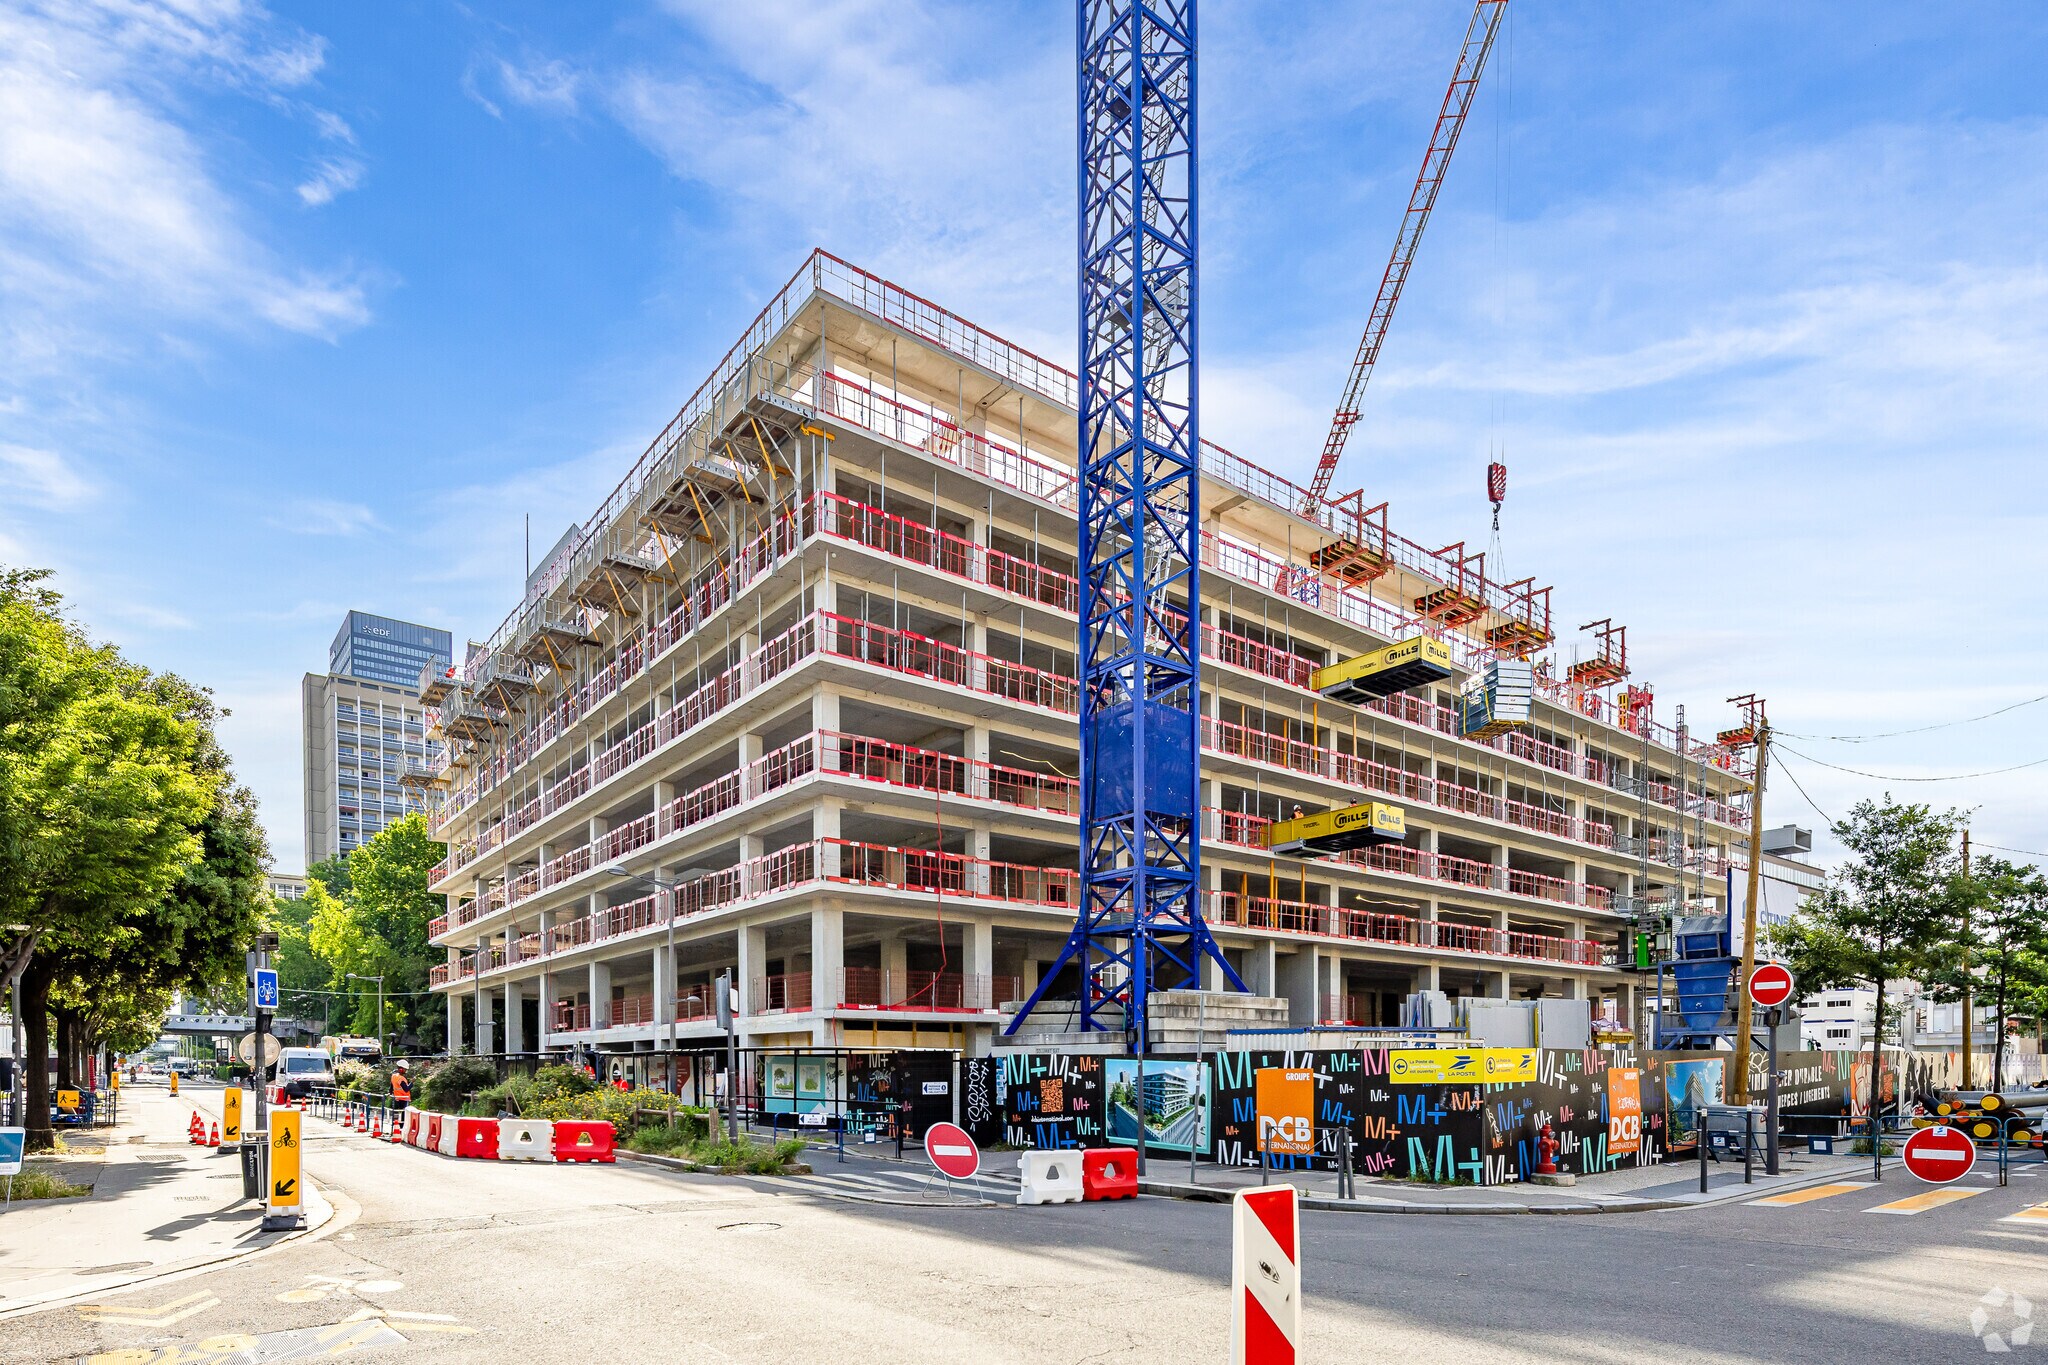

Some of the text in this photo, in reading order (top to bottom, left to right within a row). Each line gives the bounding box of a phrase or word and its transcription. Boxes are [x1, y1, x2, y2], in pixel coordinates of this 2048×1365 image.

[1007, 1054, 1047, 1085] M+
[1049, 1054, 1082, 1085] M+
[1080, 1057, 1099, 1072] M+
[1331, 1053, 1360, 1073] M+
[1536, 1048, 1567, 1089] M+
[1565, 1053, 1582, 1072] M+
[1583, 1049, 1607, 1076] M+
[1285, 1073, 1310, 1081] GROUPE
[1339, 1083, 1355, 1094] M+
[1017, 1091, 1039, 1112] M+
[1073, 1097, 1090, 1111] M+
[1370, 1089, 1390, 1102] M+
[1451, 1091, 1484, 1111] M+
[1233, 1096, 1257, 1123] M
[1321, 1099, 1355, 1126] M+
[1397, 1094, 1447, 1125] M+
[1497, 1101, 1525, 1132] M+
[1560, 1105, 1574, 1123] M+
[1007, 1125, 1035, 1147] M+
[1036, 1123, 1077, 1150] M+
[1076, 1117, 1100, 1135] M+
[1225, 1126, 1239, 1136] M+
[1260, 1115, 1312, 1142] DCB
[1365, 1116, 1400, 1140] M+
[1611, 1115, 1640, 1142] DCB
[1218, 1139, 1260, 1166] M+
[1561, 1130, 1580, 1155] M+
[1636, 1133, 1663, 1167] M+
[1365, 1152, 1395, 1173] M+
[1407, 1135, 1484, 1183] M+
[1486, 1154, 1518, 1185] M+
[1518, 1136, 1559, 1181] M
